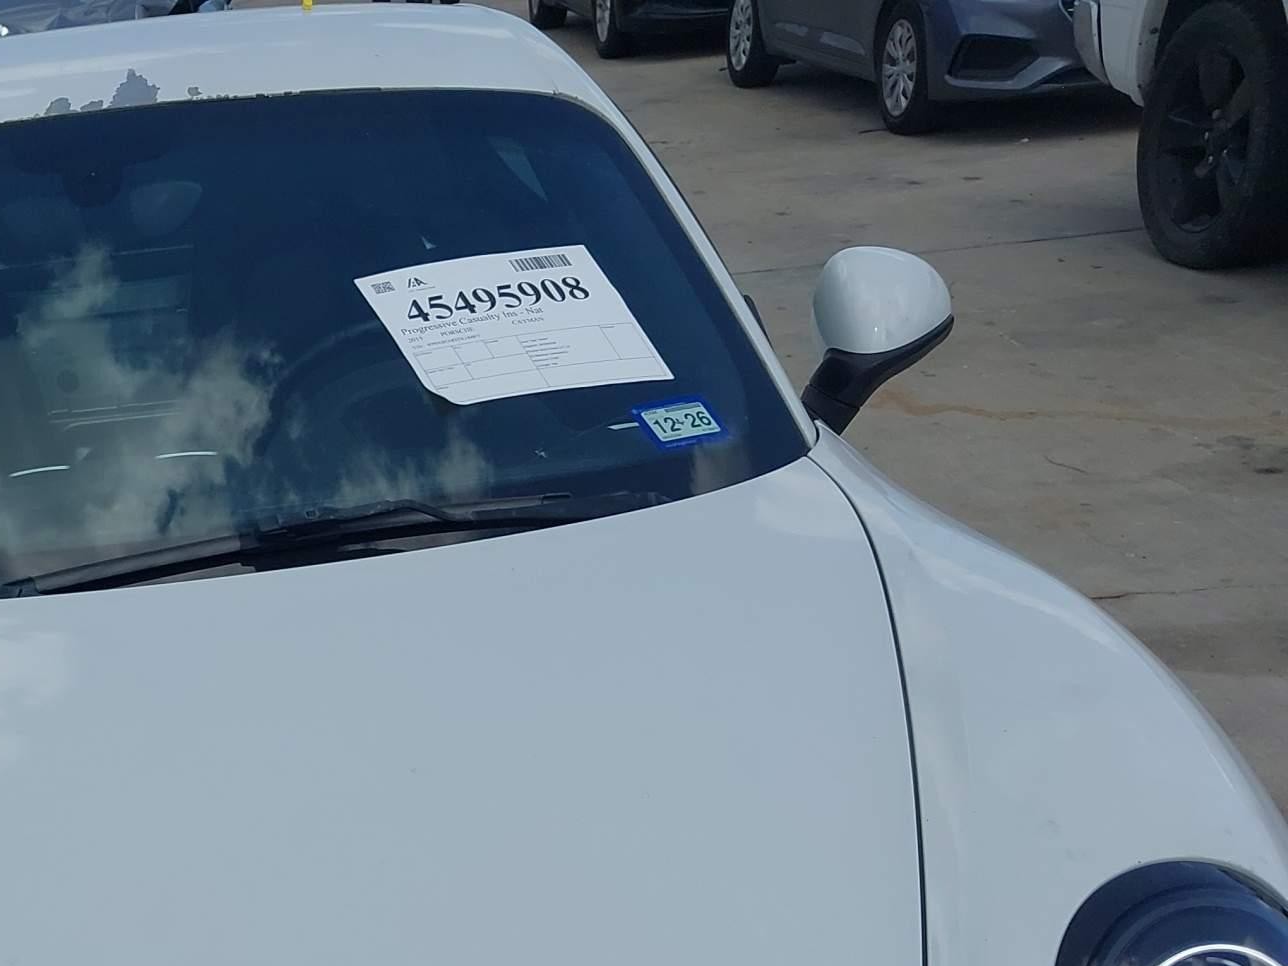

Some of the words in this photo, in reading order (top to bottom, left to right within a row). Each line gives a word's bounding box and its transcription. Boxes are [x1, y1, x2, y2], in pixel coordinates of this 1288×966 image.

[407, 276, 590, 322] 45495908
[400, 321, 458, 336] Progressive
[459, 311, 500, 325] Casualty
[502, 310, 519, 319] Ins
[524, 306, 544, 315] Nat
